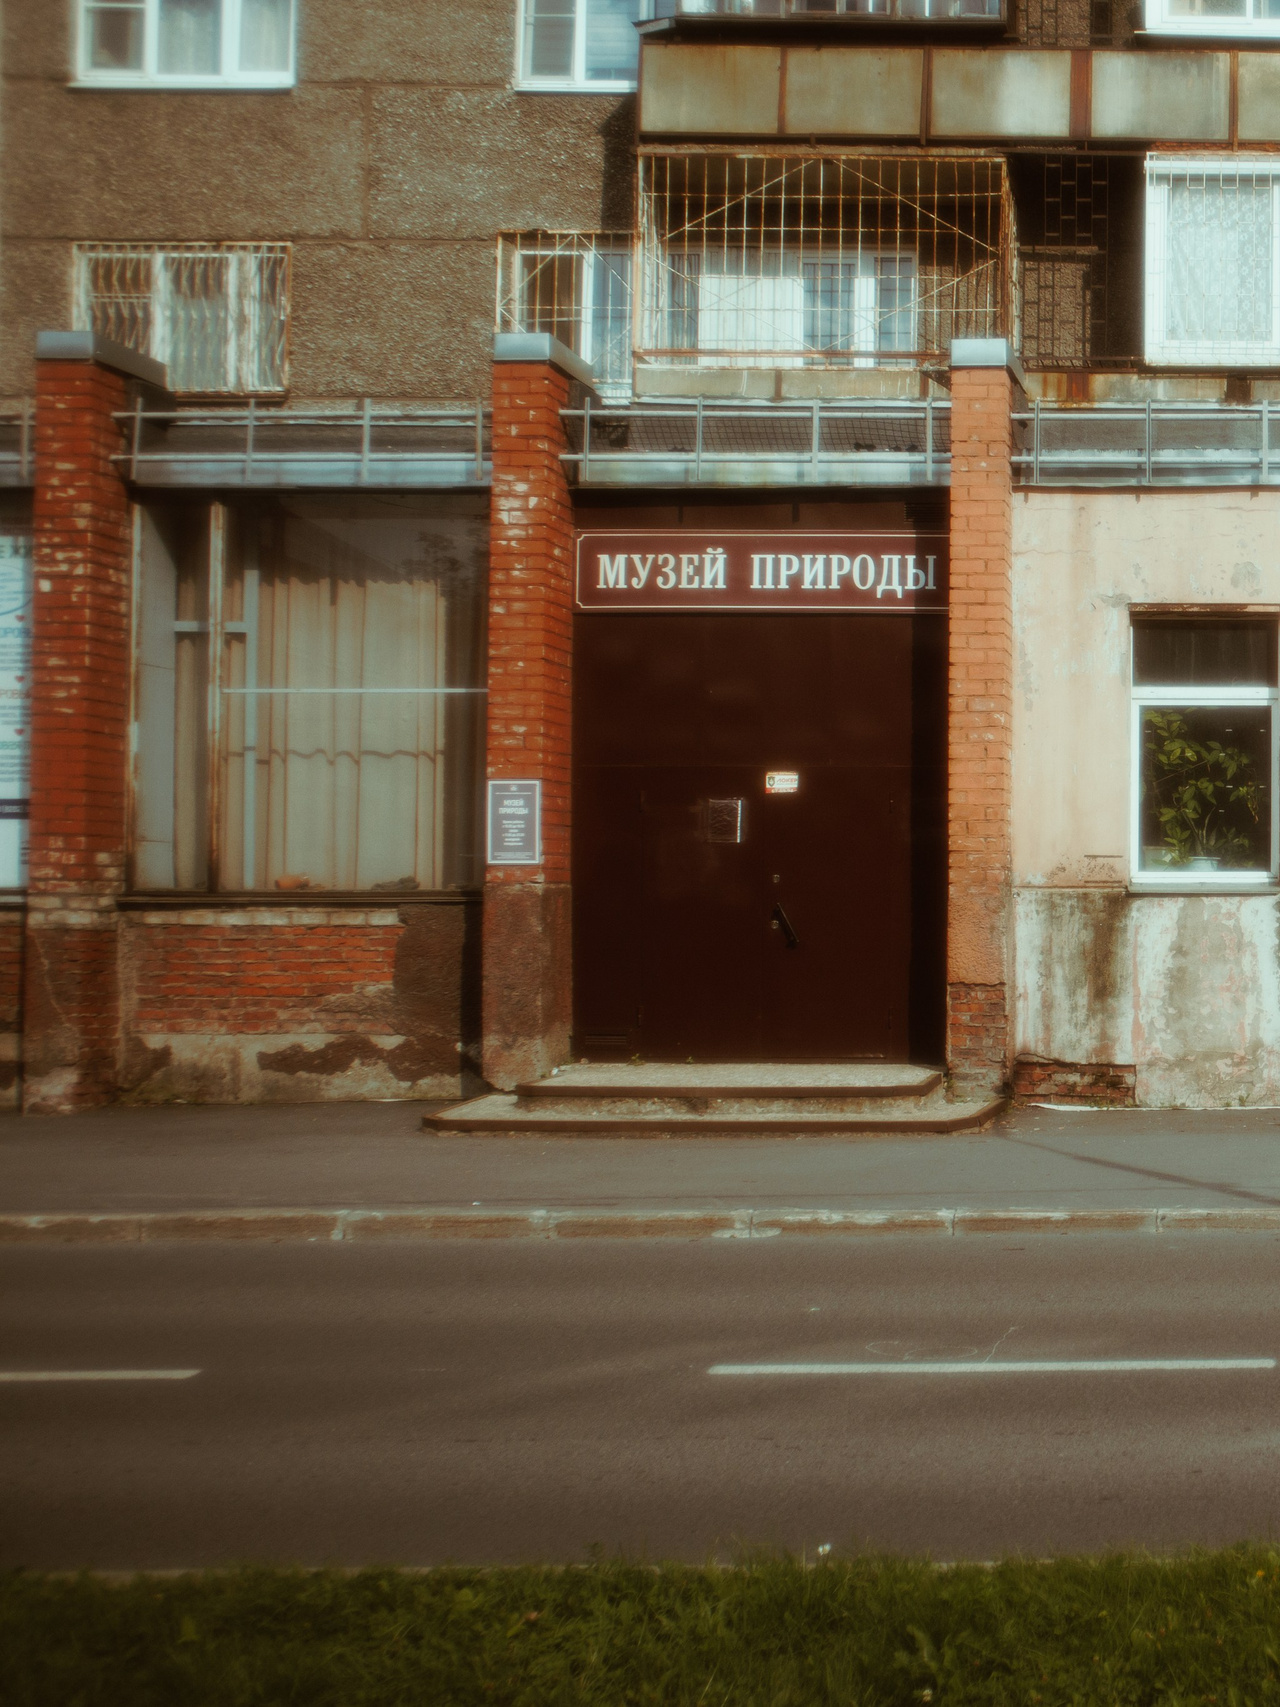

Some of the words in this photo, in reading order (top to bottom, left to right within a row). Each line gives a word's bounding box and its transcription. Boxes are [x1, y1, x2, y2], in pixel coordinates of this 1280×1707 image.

[596, 547, 728, 589] МУЗЕЙ
[750, 553, 937, 599] ПРИРОДЫ
[503, 799, 524, 807] МУЗЕЙ
